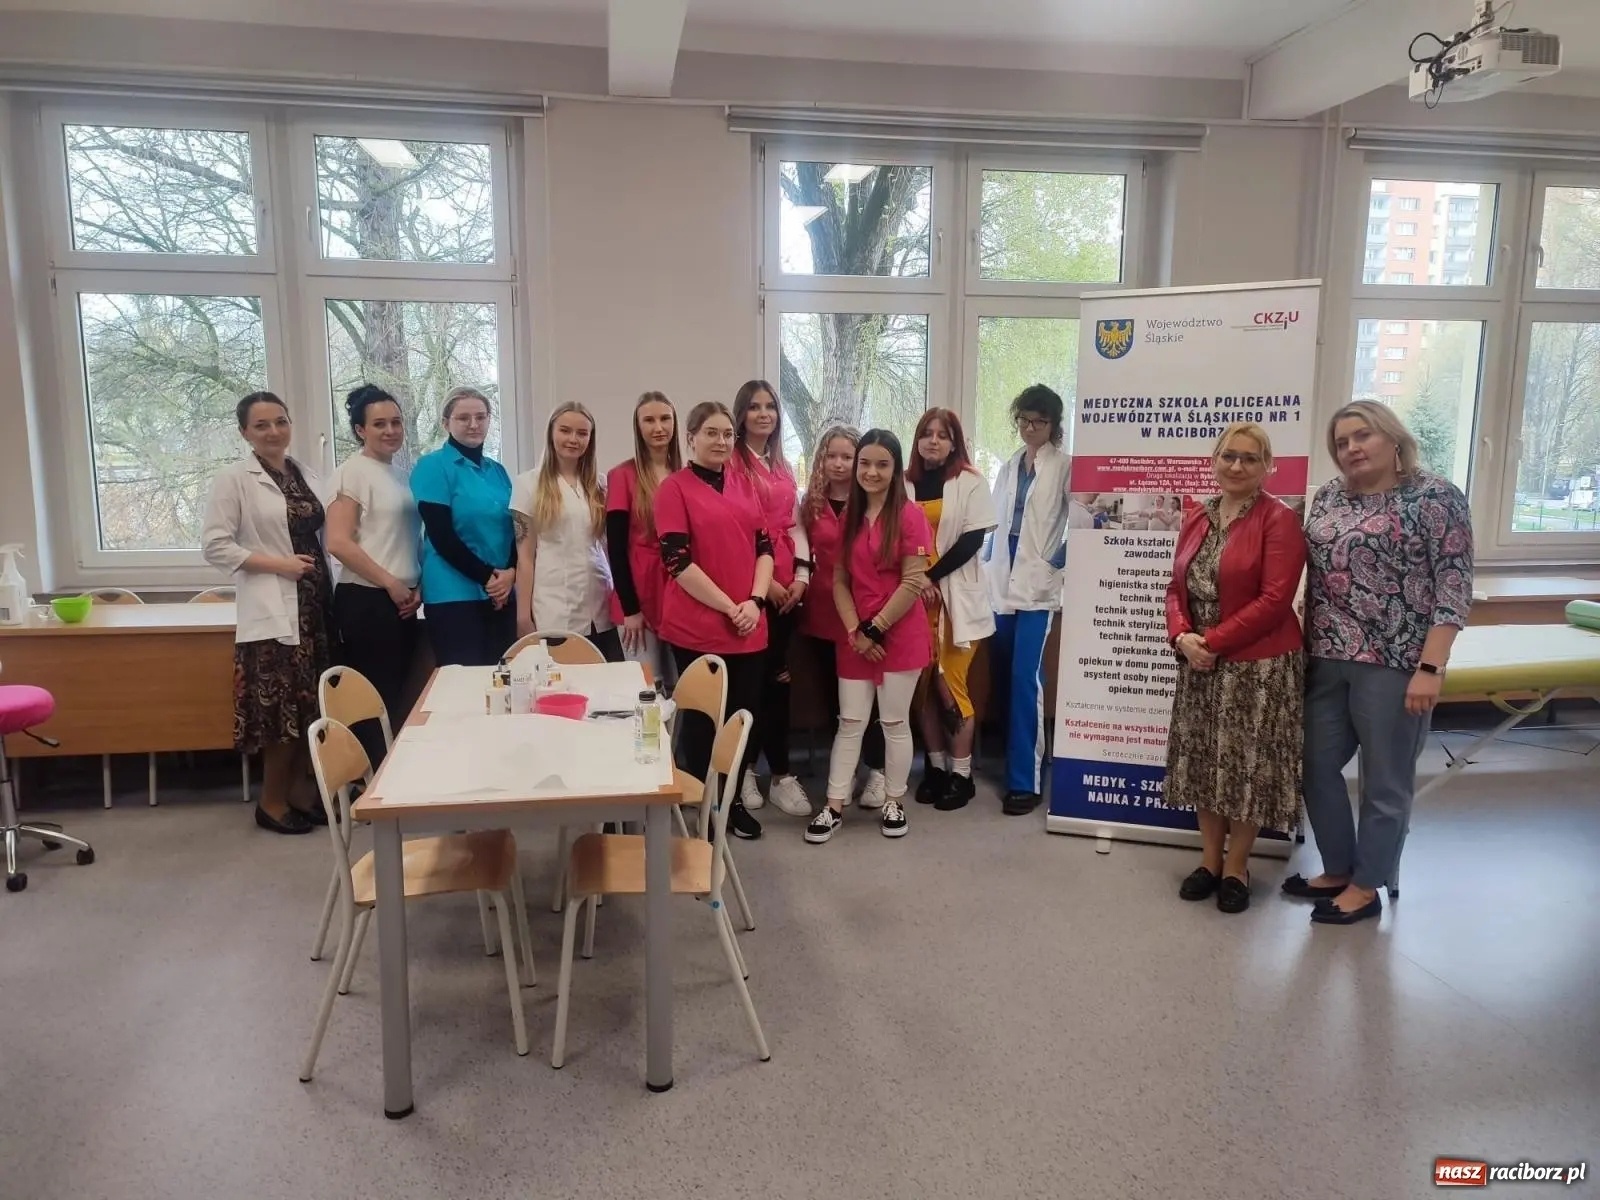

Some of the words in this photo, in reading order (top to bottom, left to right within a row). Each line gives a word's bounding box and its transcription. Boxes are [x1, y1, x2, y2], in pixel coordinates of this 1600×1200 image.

[1146, 318, 1223, 331] Województwo
[1144, 332, 1184, 345] Śląskie
[1083, 397, 1153, 409] MEDYCZNA
[1158, 396, 1209, 408] SZKOŁA
[1215, 395, 1301, 407] POLICEALNA
[1081, 410, 1182, 423] WOJEWÓDZTWA
[1187, 410, 1263, 425] ŚLĄSKIEGO
[1269, 411, 1288, 422] NR
[1294, 411, 1301, 421] 1
[1141, 427, 1151, 438] W
[1157, 427, 1224, 438] RACIBORZ
[1103, 535, 1135, 546] Szkoła
[1137, 536, 1175, 547] kształci
[1124, 549, 1172, 559] zawodach
[1117, 567, 1160, 578] terapeuta
[1099, 579, 1148, 590] higienistka
[1119, 593, 1152, 603] technik
[1155, 595, 1166, 603] ma
[1095, 605, 1128, 615] technik
[1130, 607, 1154, 617] usług
[1156, 608, 1166, 616] ko
[1093, 618, 1126, 628] technik
[1128, 620, 1166, 631] steryliza
[1099, 632, 1132, 641] technik
[1112, 645, 1158, 656] opiekunka
[1078, 656, 1113, 668] opiekun
[1125, 658, 1149, 669] domu
[1151, 662, 1180, 671] pomoc
[1083, 670, 1121, 680] asystent
[1123, 672, 1149, 683] osoby
[1151, 674, 1176, 685] niepe
[1108, 685, 1144, 696] opiekun
[1145, 686, 1175, 698] medyc
[1066, 701, 1105, 711] Kształcenie
[1114, 704, 1147, 714] systemie
[1065, 718, 1111, 730] Kształcenie
[1112, 723, 1122, 731] na
[1124, 724, 1168, 735] wszystkich
[1069, 731, 1081, 739] nie
[1083, 733, 1125, 744] wymagana
[1126, 736, 1141, 745] jest
[1143, 738, 1168, 747] matur
[1082, 774, 1127, 789] MEDYK
[1140, 780, 1163, 792] SZK
[1087, 791, 1129, 806] NAUKA
[1133, 795, 1141, 807] Z
